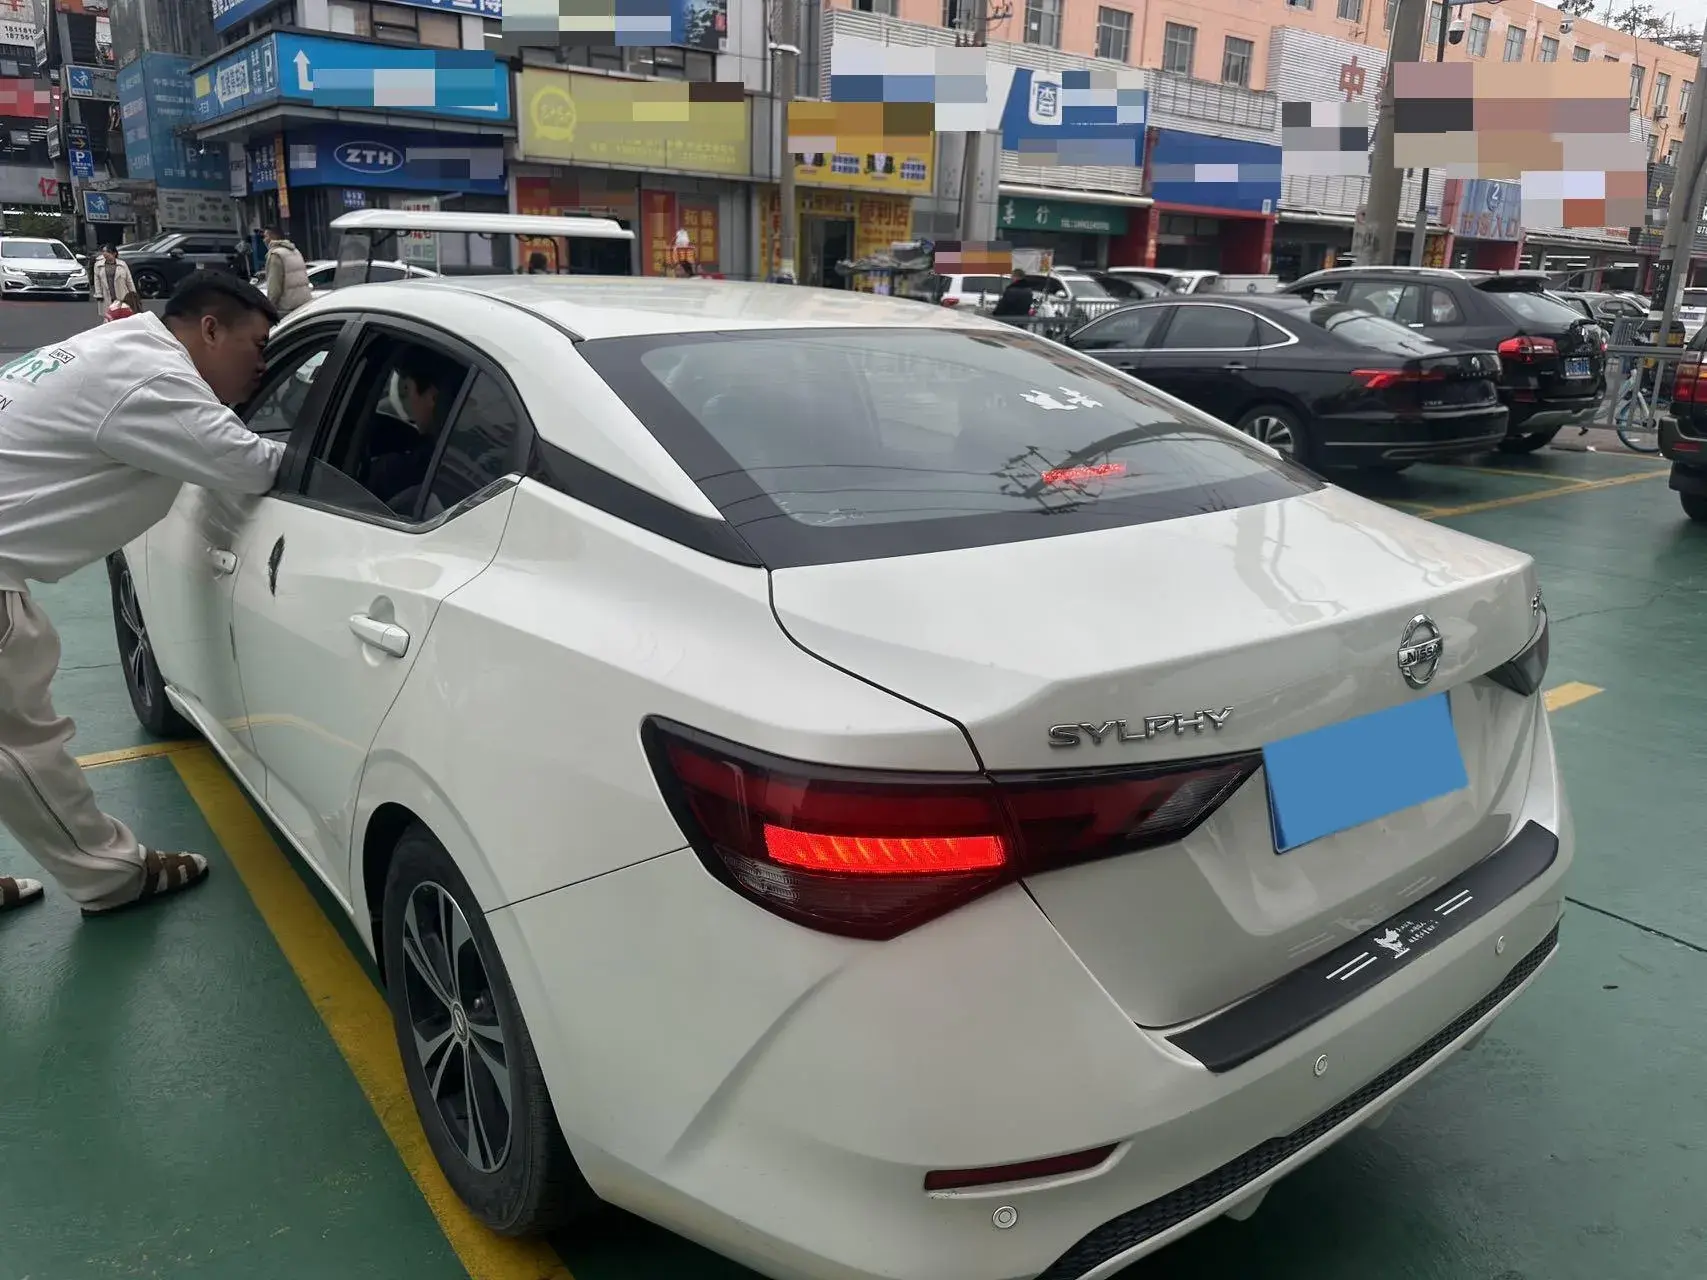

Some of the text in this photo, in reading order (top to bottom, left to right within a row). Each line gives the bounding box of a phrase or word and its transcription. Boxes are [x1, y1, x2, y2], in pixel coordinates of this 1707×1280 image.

[75, 151, 85, 162] P
[345, 148, 394, 166] ZTH
[1491, 183, 1500, 200] 2
[1048, 705, 1235, 747] SYLPHY
